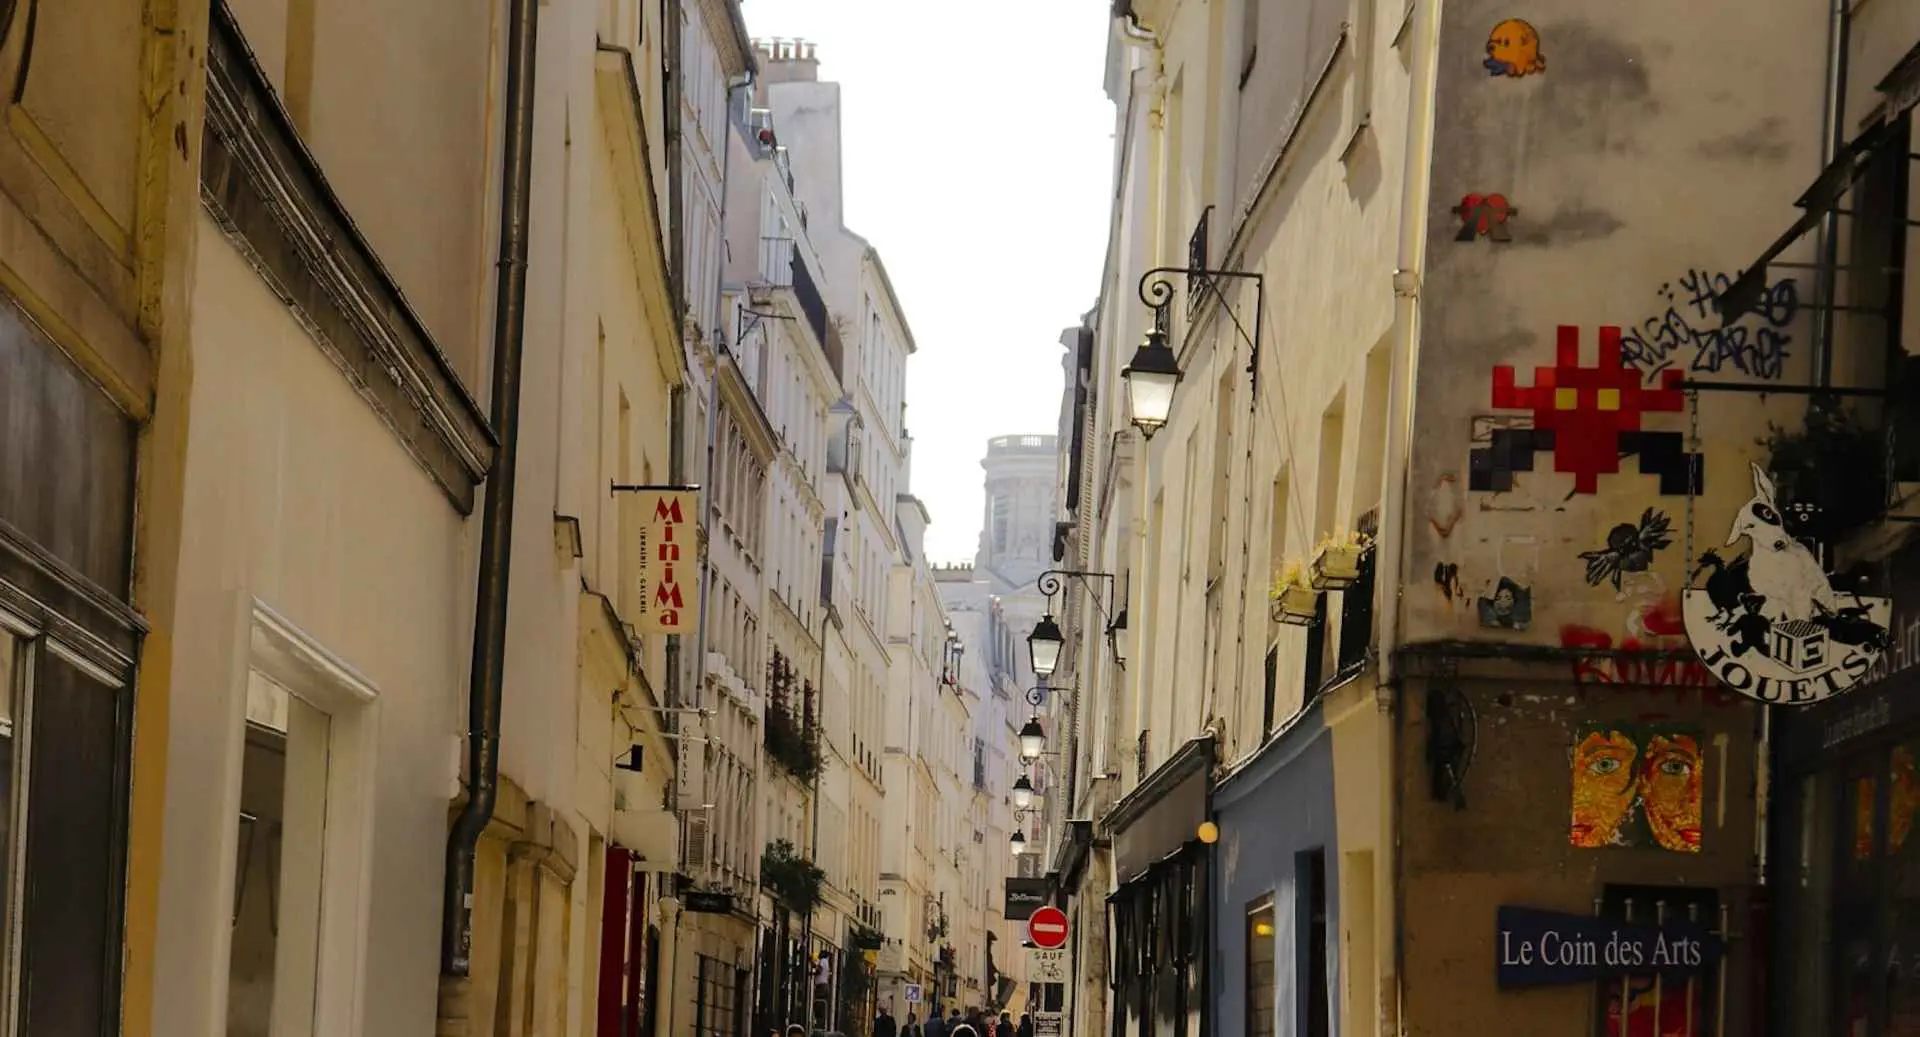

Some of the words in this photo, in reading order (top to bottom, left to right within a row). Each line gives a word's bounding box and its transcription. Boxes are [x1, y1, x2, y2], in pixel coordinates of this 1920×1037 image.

[1699, 645, 1871, 702] JOUETS
[1033, 951, 1064, 961] SAUF
[1502, 930, 1534, 965] Le
[1540, 930, 1598, 966] Coin
[1604, 929, 1644, 966] des
[1650, 931, 1702, 966] Arts
